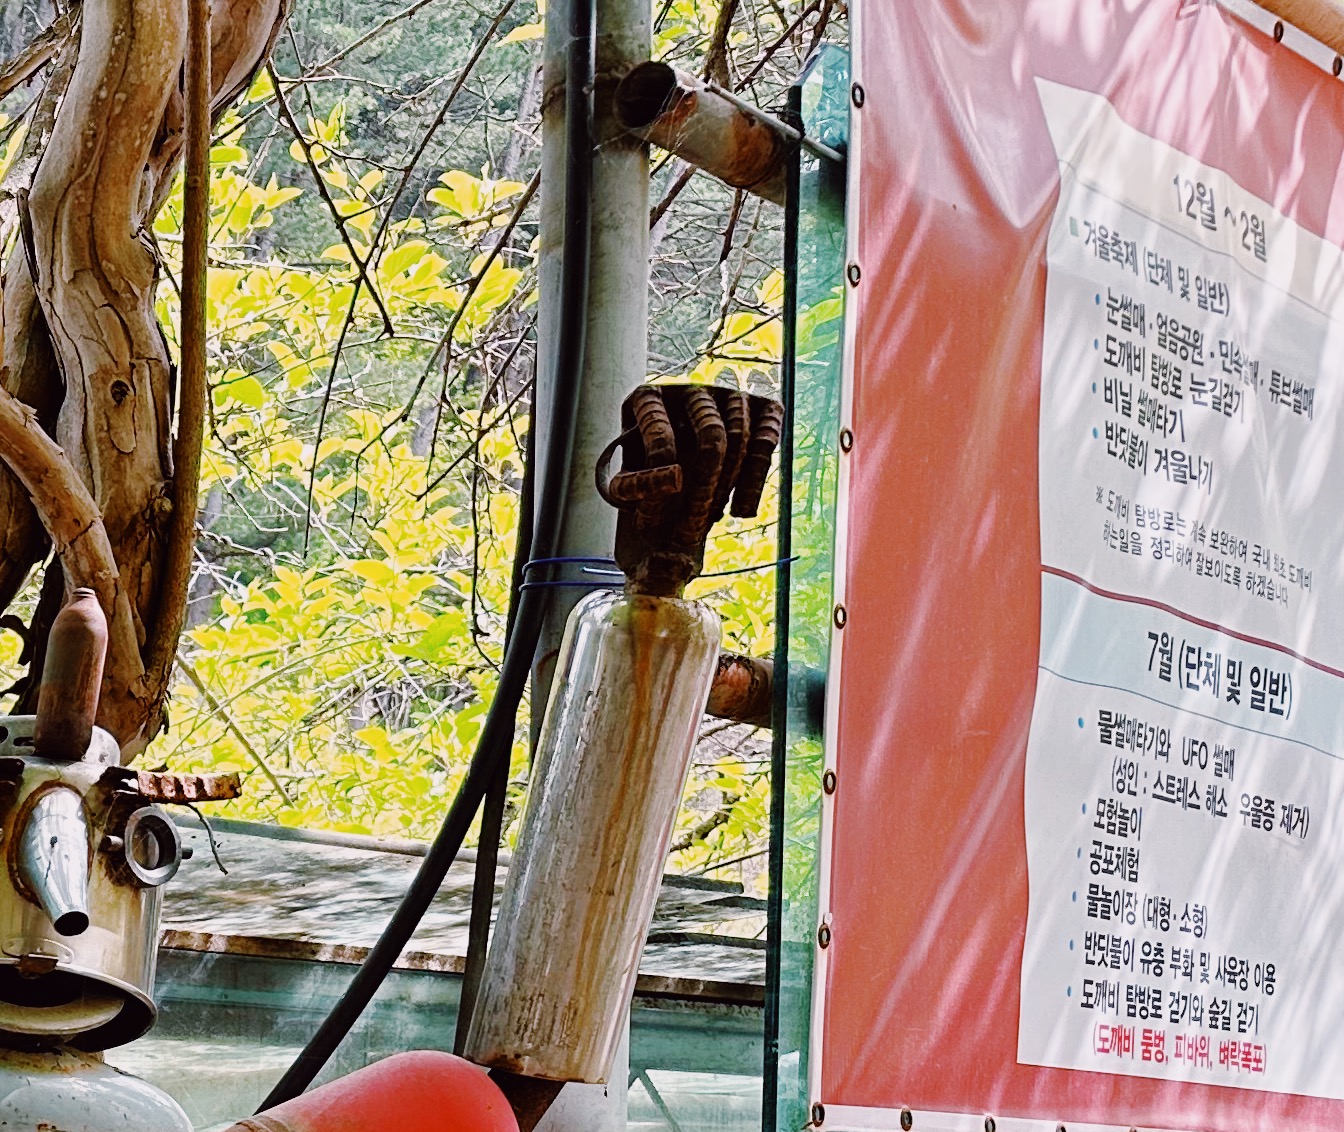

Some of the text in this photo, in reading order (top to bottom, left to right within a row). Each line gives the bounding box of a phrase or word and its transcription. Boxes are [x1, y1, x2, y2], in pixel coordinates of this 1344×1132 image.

[1173, 174, 1217, 231] 12월
[1241, 211, 1267, 263] 2월
[1083, 219, 1230, 318] 겨울축제 (단체 및 일반)
[1106, 287, 1146, 338] 눈썰매
[1156, 312, 1204, 367] 얼음공원
[1103, 376, 1186, 443] 비닐 썰매타기
[1104, 334, 1244, 424] 도깨비 탐방로 눈길걷기
[1104, 419, 1213, 495] 반딧불이 겨울나기
[1135, 504, 1186, 537] 탐방로는
[1252, 544, 1271, 572] 국내
[1196, 551, 1242, 591] 잘보이도록
[1147, 631, 1294, 720] 7월 (단체 및 일반)
[1097, 709, 1235, 782] 물썰매타기와 UFO 썰매
[1093, 797, 1143, 841] 모험놀이
[1111, 755, 1140, 797] (성인
[1151, 768, 1201, 811] 스트레스
[1206, 783, 1228, 819] 해소
[1239, 792, 1276, 832] 우울증
[1279, 802, 1310, 839] 제거)
[1089, 840, 1140, 883] 공포체험
[1086, 883, 1138, 926] 물놀이장
[1084, 930, 1277, 996] 반딧불이 유충 부화 및 사육장 이용
[1080, 978, 1259, 1036] 도깨비 탐방로 걷기와 숲길 걷기
[1093, 1021, 1135, 1060] (도깨비
[1174, 1033, 1213, 1071] 피바위,
